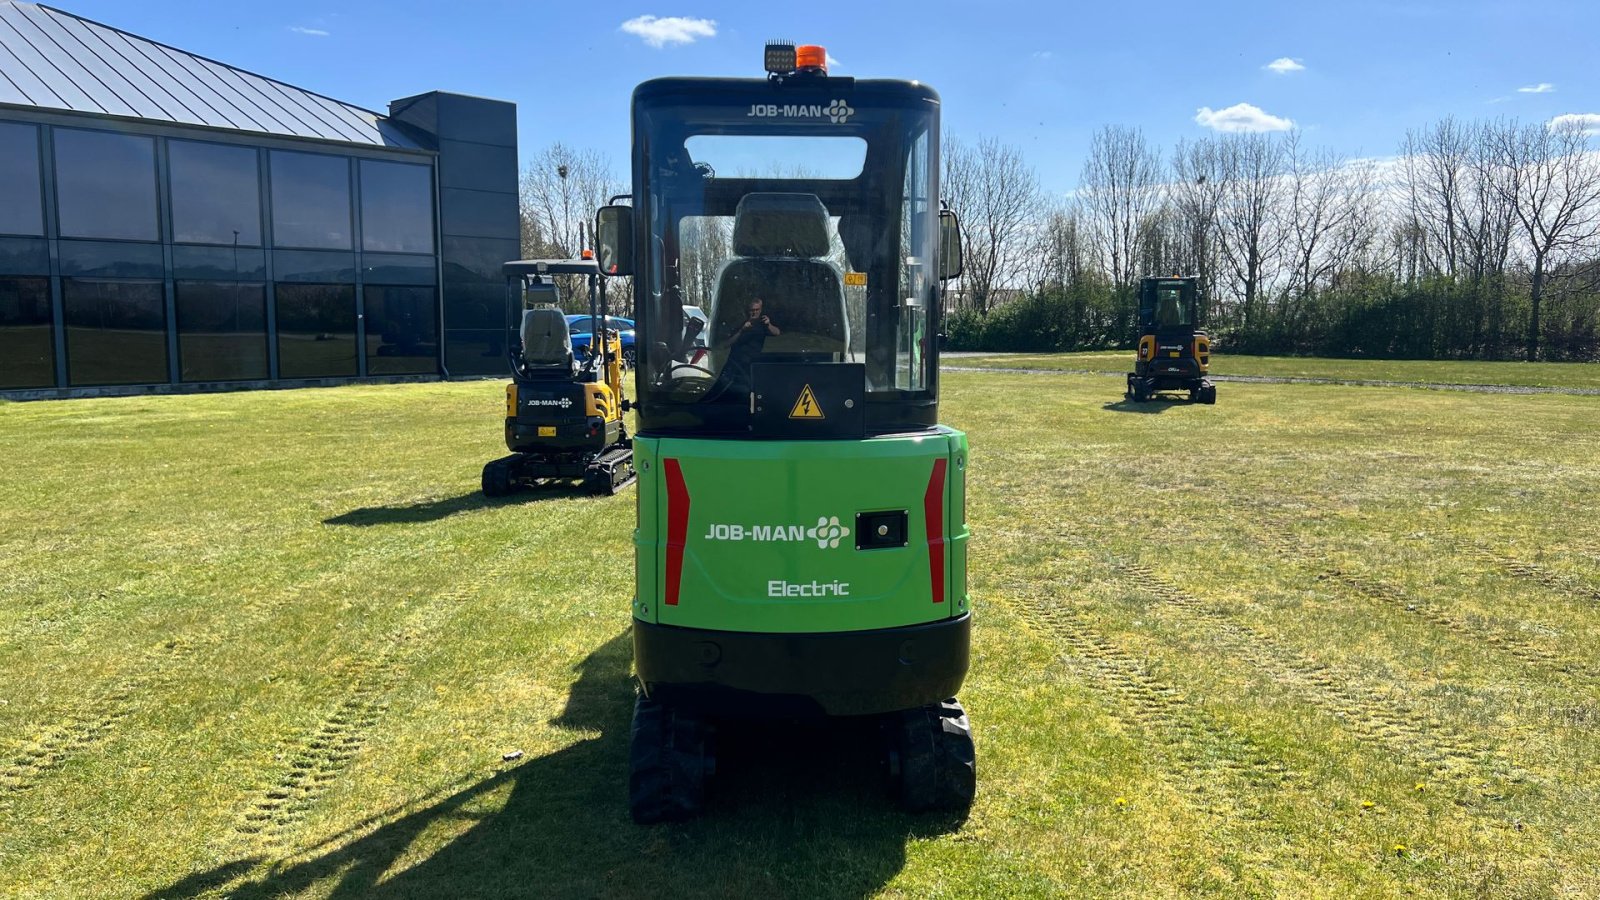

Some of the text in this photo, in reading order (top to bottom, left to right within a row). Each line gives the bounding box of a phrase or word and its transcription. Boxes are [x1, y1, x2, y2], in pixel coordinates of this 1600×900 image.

[747, 104, 821, 117] JOB-MAN
[705, 524, 805, 541] JOB-MAN
[768, 580, 849, 597] Electric
